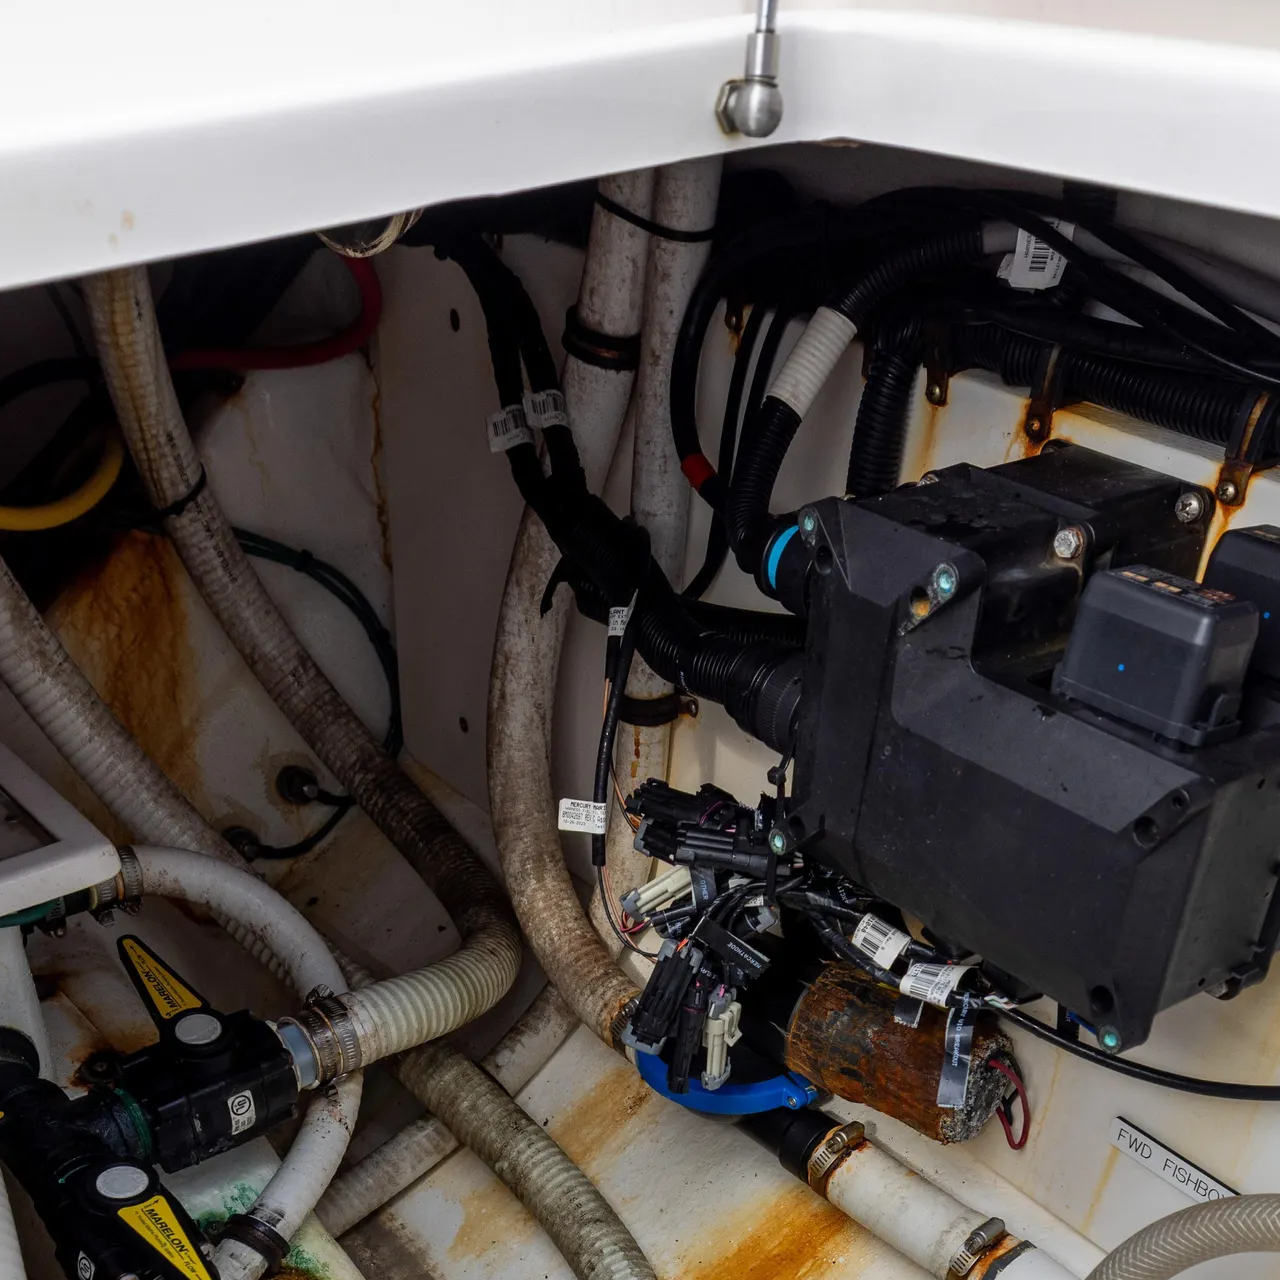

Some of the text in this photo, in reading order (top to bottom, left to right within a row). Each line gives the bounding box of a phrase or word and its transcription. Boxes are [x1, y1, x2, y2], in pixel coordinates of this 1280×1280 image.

[726, 941, 762, 969] MERCATHODE
[141, 970, 176, 1009] MARELON
[1117, 1128, 1226, 1200] FWD FISHBO
[145, 1207, 188, 1253] MARELON
